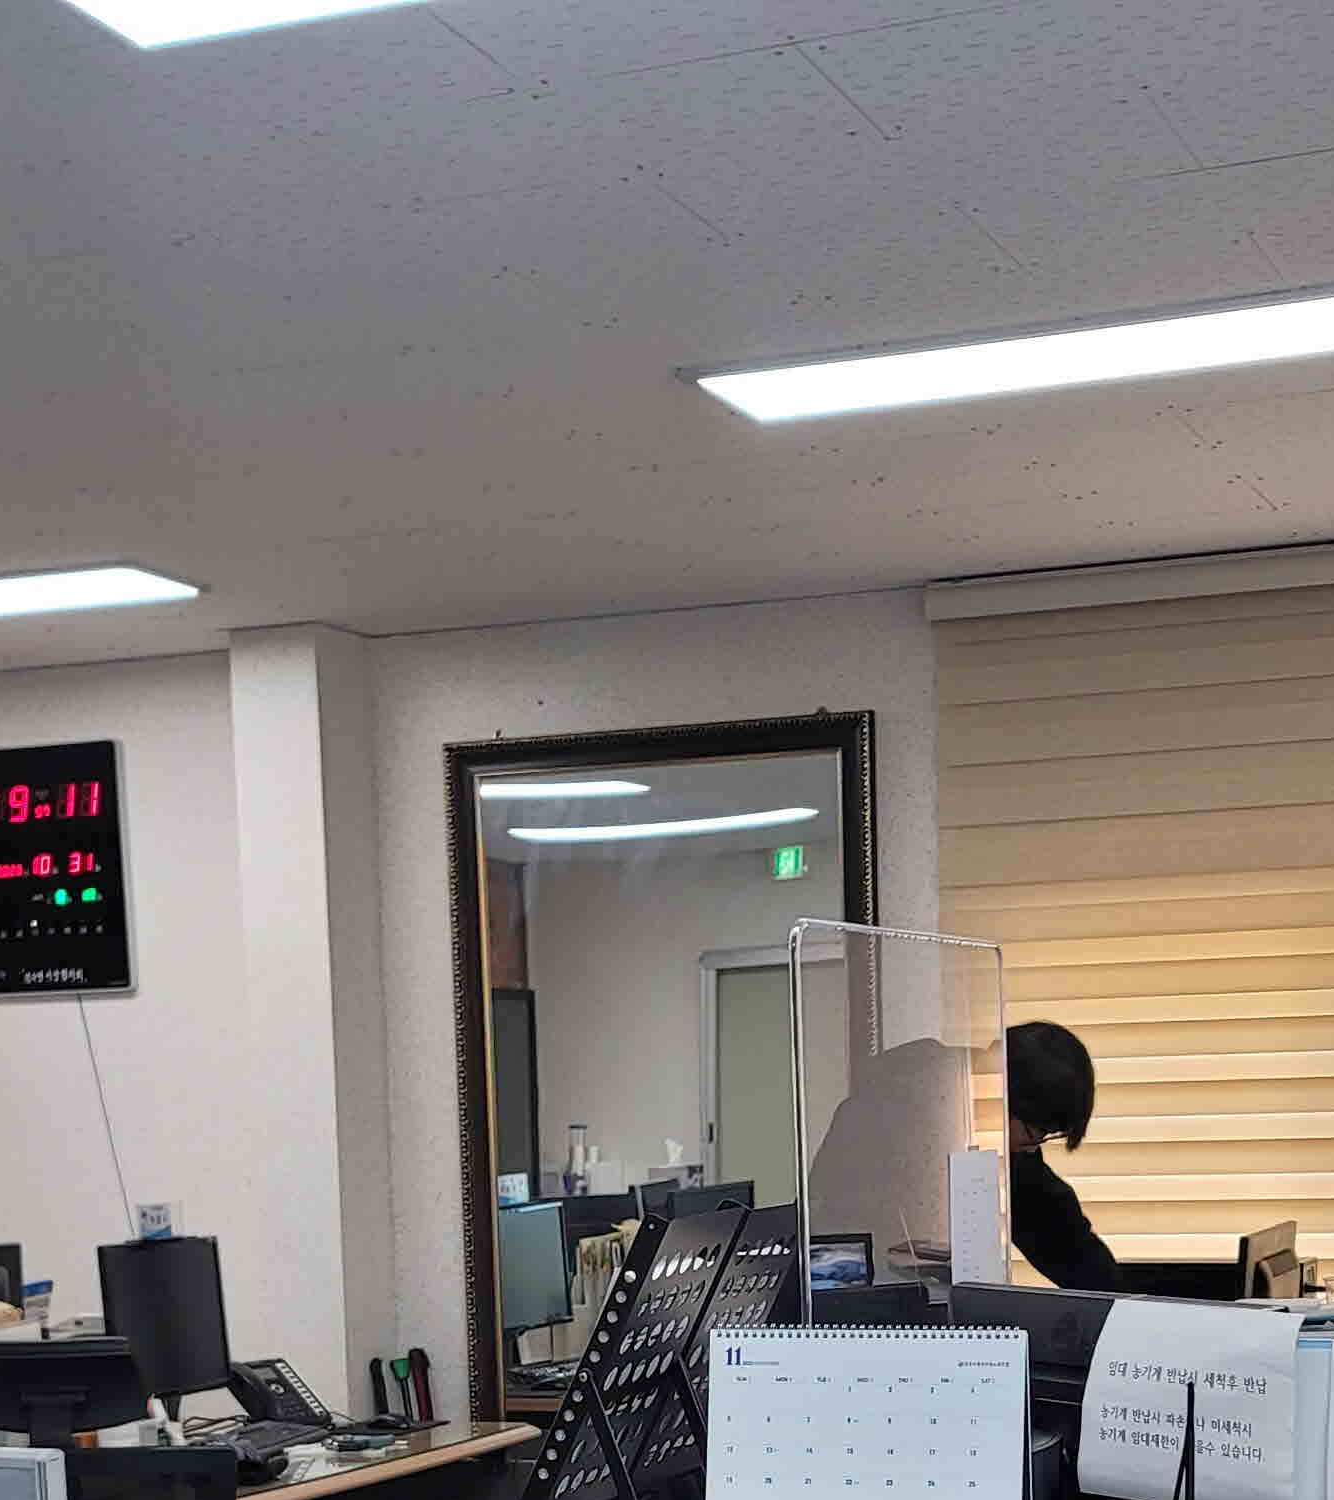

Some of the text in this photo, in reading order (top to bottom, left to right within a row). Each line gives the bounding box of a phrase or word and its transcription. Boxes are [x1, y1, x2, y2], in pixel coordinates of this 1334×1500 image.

[8, 785, 29, 822] 9
[66, 781, 99, 817] 11
[32, 853, 52, 877] 10
[69, 851, 94, 876] 31
[726, 1346, 741, 1366] 11
[1108, 1362, 1128, 1376] 임대
[1243, 1376, 1267, 1394] 반납
[1132, 1409, 1160, 1424] 반납시
